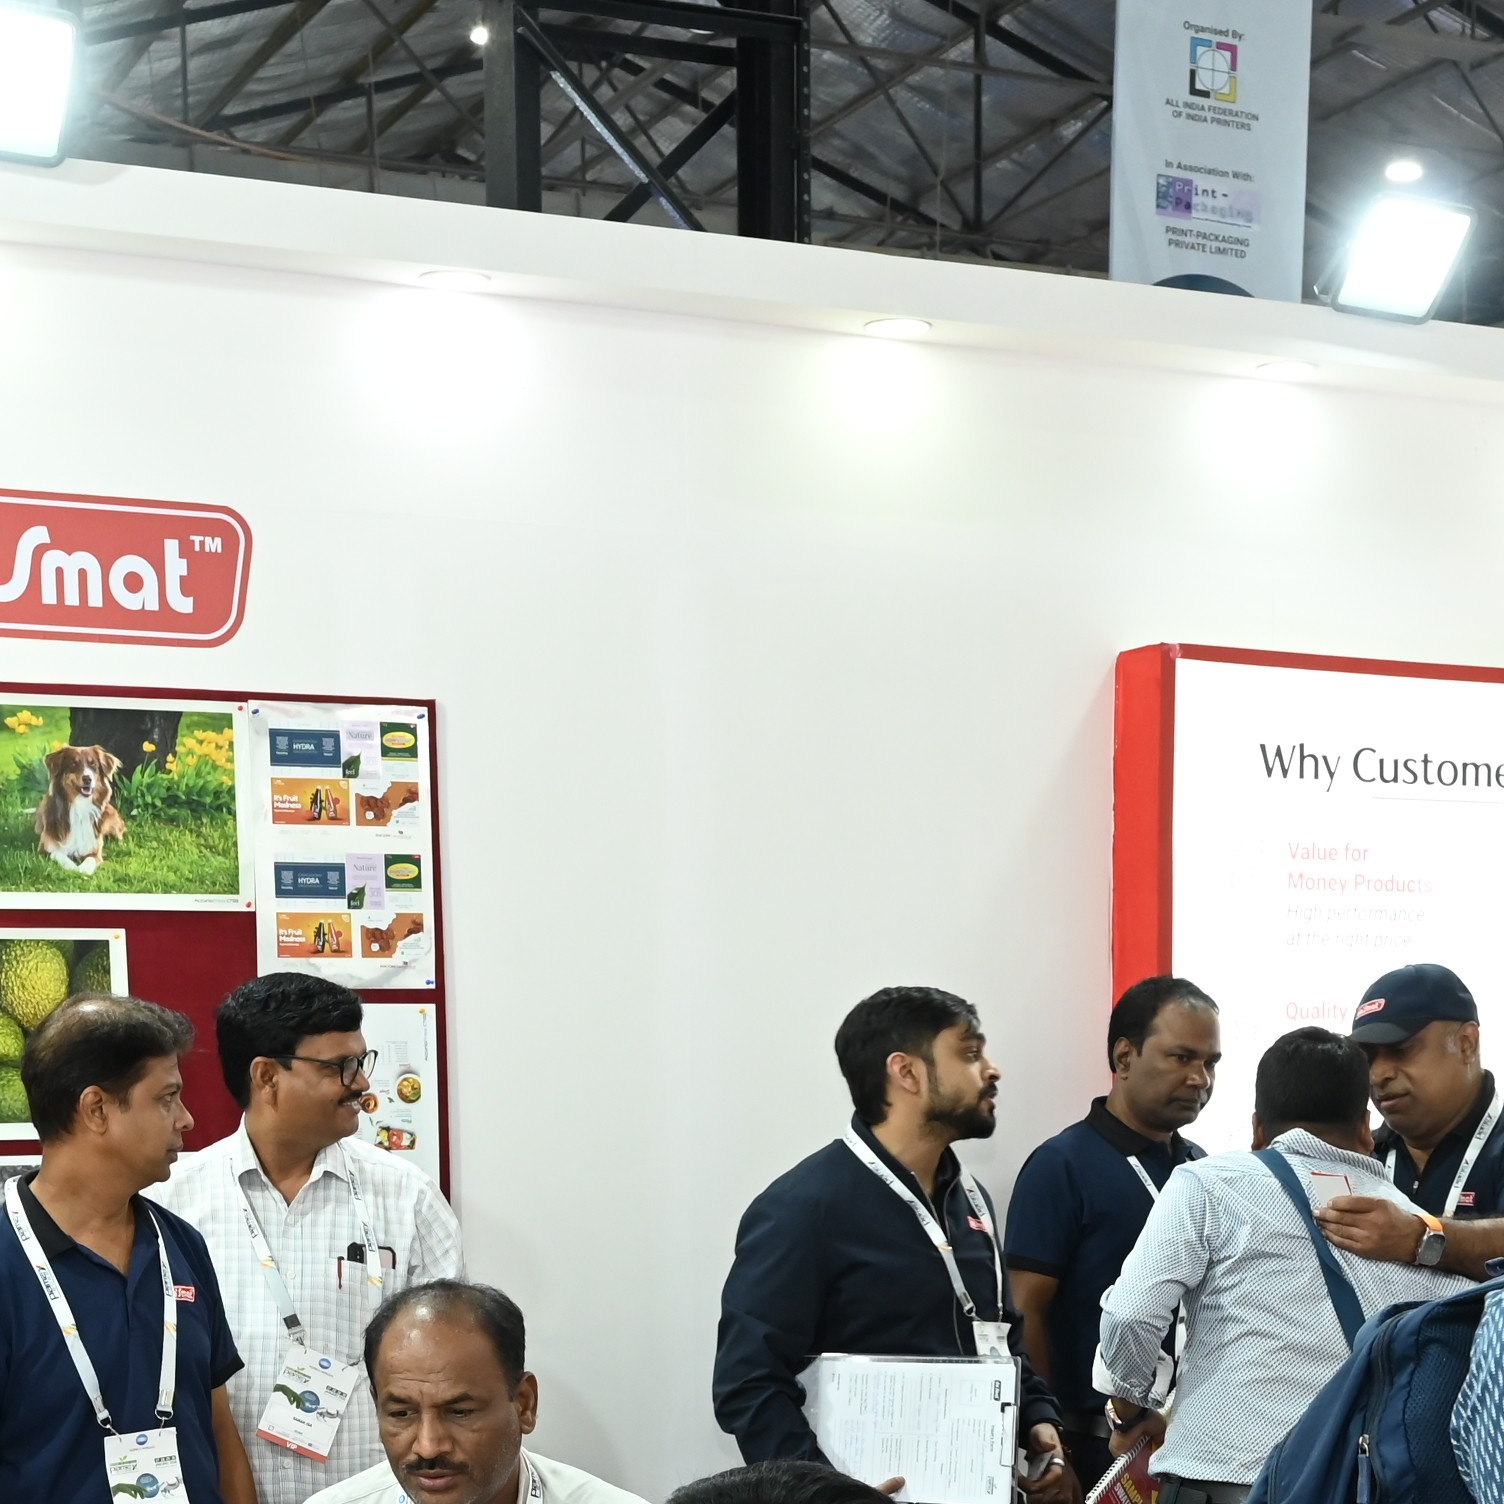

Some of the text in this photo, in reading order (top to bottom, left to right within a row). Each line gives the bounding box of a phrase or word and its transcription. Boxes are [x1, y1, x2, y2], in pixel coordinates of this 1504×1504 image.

[1183, 21, 1244, 41] Organised By:
[1165, 98, 1259, 121] ALL INDIA FEDERATION
[1172, 110, 1251, 131] OF INDIA PRINTERS
[1165, 159, 1254, 182] In Association With:
[1166, 226, 1250, 248] PRINT-PACKAGING
[1168, 238, 1246, 259] PRIVATE LIMITED
[348, 730, 372, 740] Nature
[1259, 743, 1341, 792] Why
[1288, 842, 1369, 862] Value for
[353, 863, 377, 872] Nature
[1288, 872, 1432, 896] Money Products
[1286, 1002, 1348, 1023] Quality
[286, 1441, 297, 1450] VIP
